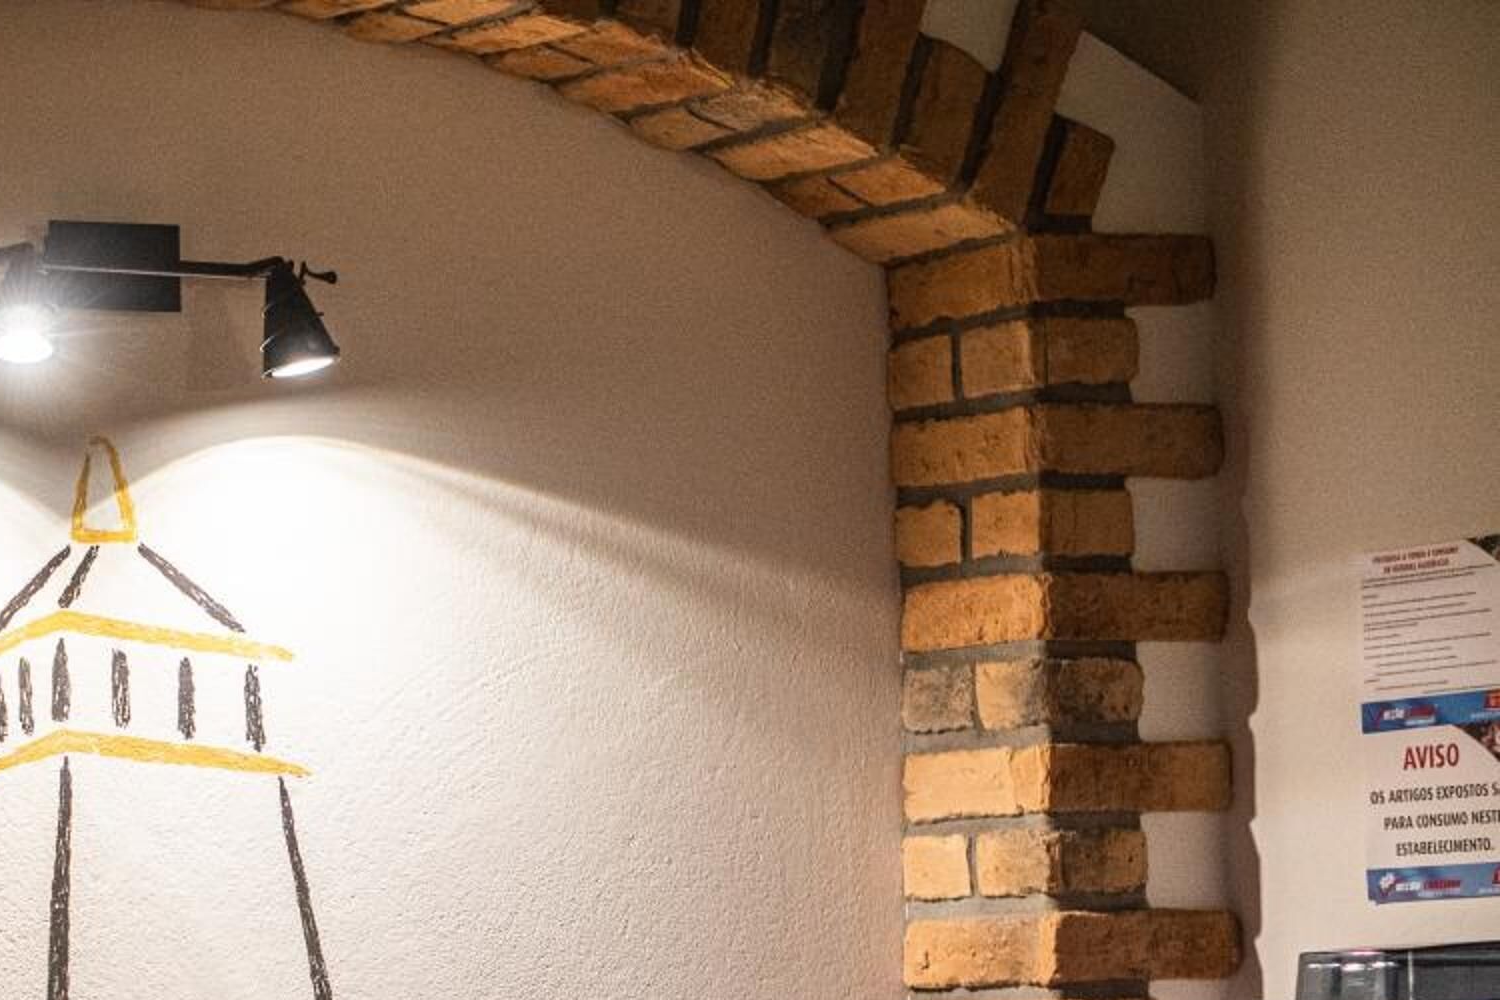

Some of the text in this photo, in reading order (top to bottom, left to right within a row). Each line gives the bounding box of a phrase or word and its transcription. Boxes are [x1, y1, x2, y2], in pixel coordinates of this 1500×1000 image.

[1403, 743, 1460, 771] AVISO
[1370, 781, 1500, 805] OS ARTIGOS EXPOSTOS S
[1383, 815, 1414, 831] PARA
[1416, 811, 1469, 829] CONSUMO
[1396, 837, 1495, 857] ESTABELECIMENTO.
